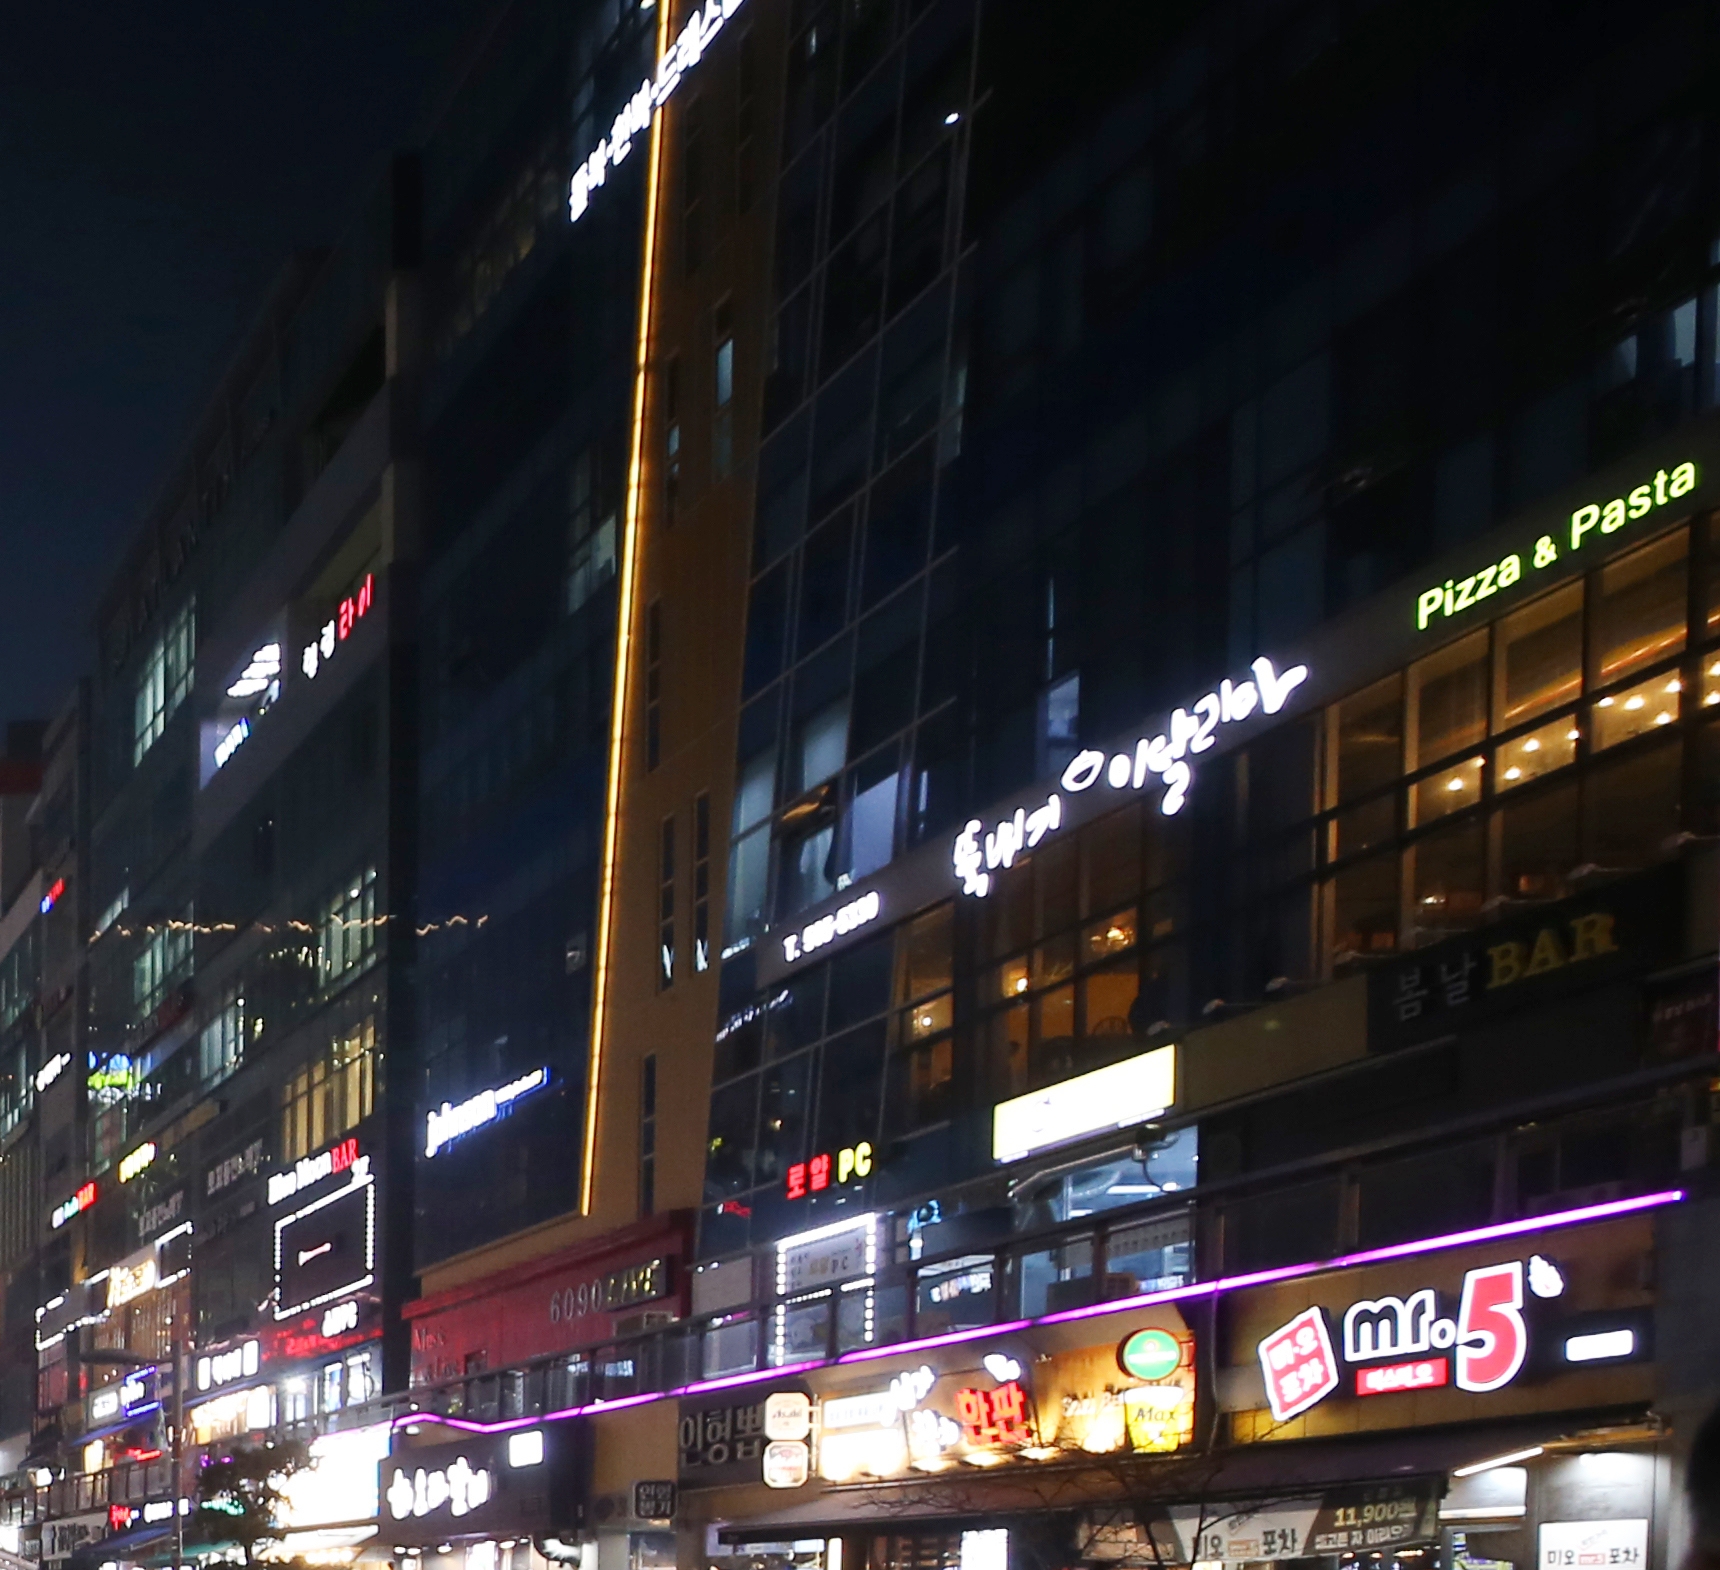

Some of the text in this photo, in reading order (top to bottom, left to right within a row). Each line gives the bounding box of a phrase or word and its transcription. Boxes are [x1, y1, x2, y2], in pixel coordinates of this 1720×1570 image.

[1416, 459, 1698, 631] Pizza & Pasta
[1391, 910, 1620, 1023] 봄날 BAR
[331, 1138, 360, 1175] BAR
[786, 1141, 873, 1200] 로얄 PC
[550, 1278, 603, 1324] 6090
[679, 1403, 765, 1468] 인형뽑
[954, 1382, 1032, 1446] 한판
[1262, 1528, 1298, 1555] 포차
[1547, 1550, 1576, 1567] 미오
[1609, 1548, 1640, 1564] 포차
